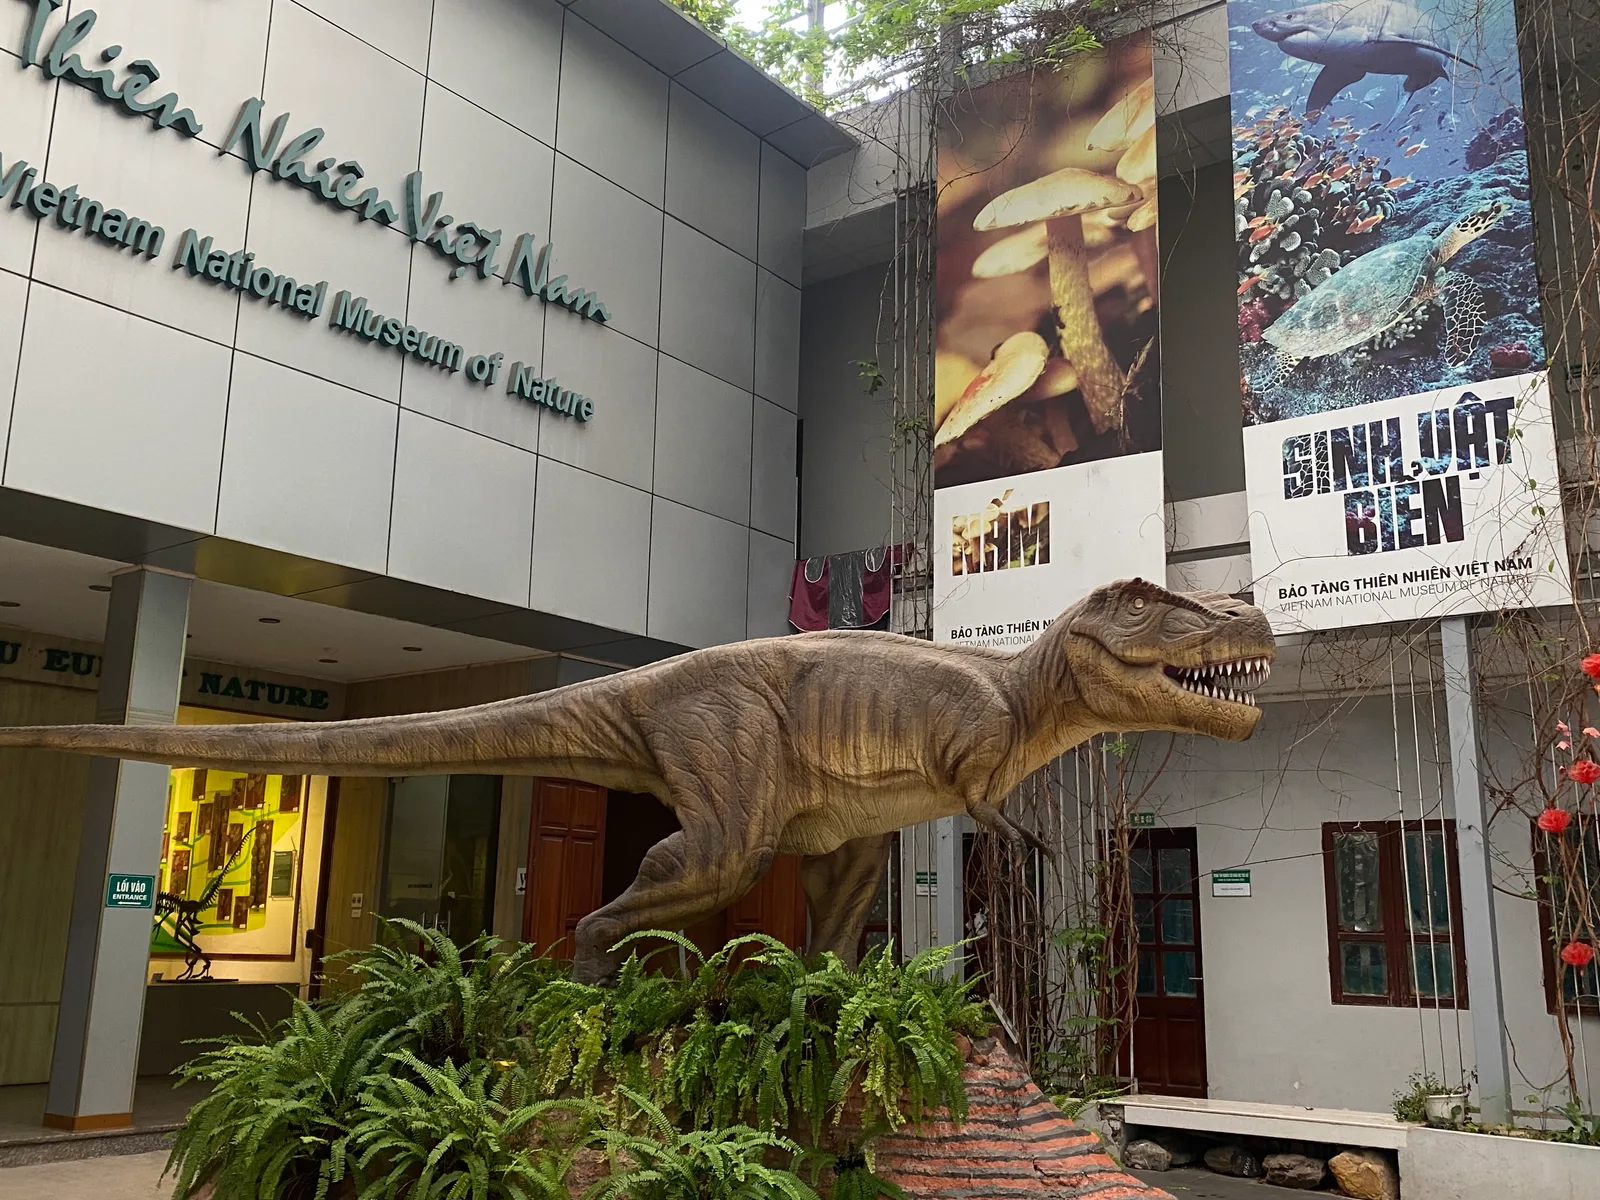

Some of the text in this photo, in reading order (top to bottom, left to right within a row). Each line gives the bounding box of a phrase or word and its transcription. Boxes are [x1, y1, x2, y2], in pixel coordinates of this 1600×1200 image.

[17, 0, 612, 323] Thiên Nhiên Việt Nam
[0, 151, 595, 423] Vietnam National Museum of Nature
[1282, 391, 1515, 500] SINH VẬT
[1343, 460, 1465, 556] BIỂN
[952, 488, 1050, 576] NẤM
[1278, 557, 1533, 600] BẢO TÀNG THIÊN NHIÊN VIỆT NAM
[1280, 597, 1333, 612] VIETNAM
[1336, 590, 1397, 606] NATIONAL
[1400, 581, 1457, 598] MUSEUM
[1460, 579, 1477, 591] OF
[951, 625, 973, 640] BẢO
[975, 623, 1004, 637] TÀNG
[1007, 619, 1040, 635] THIÊN
[198, 672, 329, 710] NATURE
[112, 893, 148, 901] ENTRANCE
[116, 877, 146, 893] LỐI VÀO
